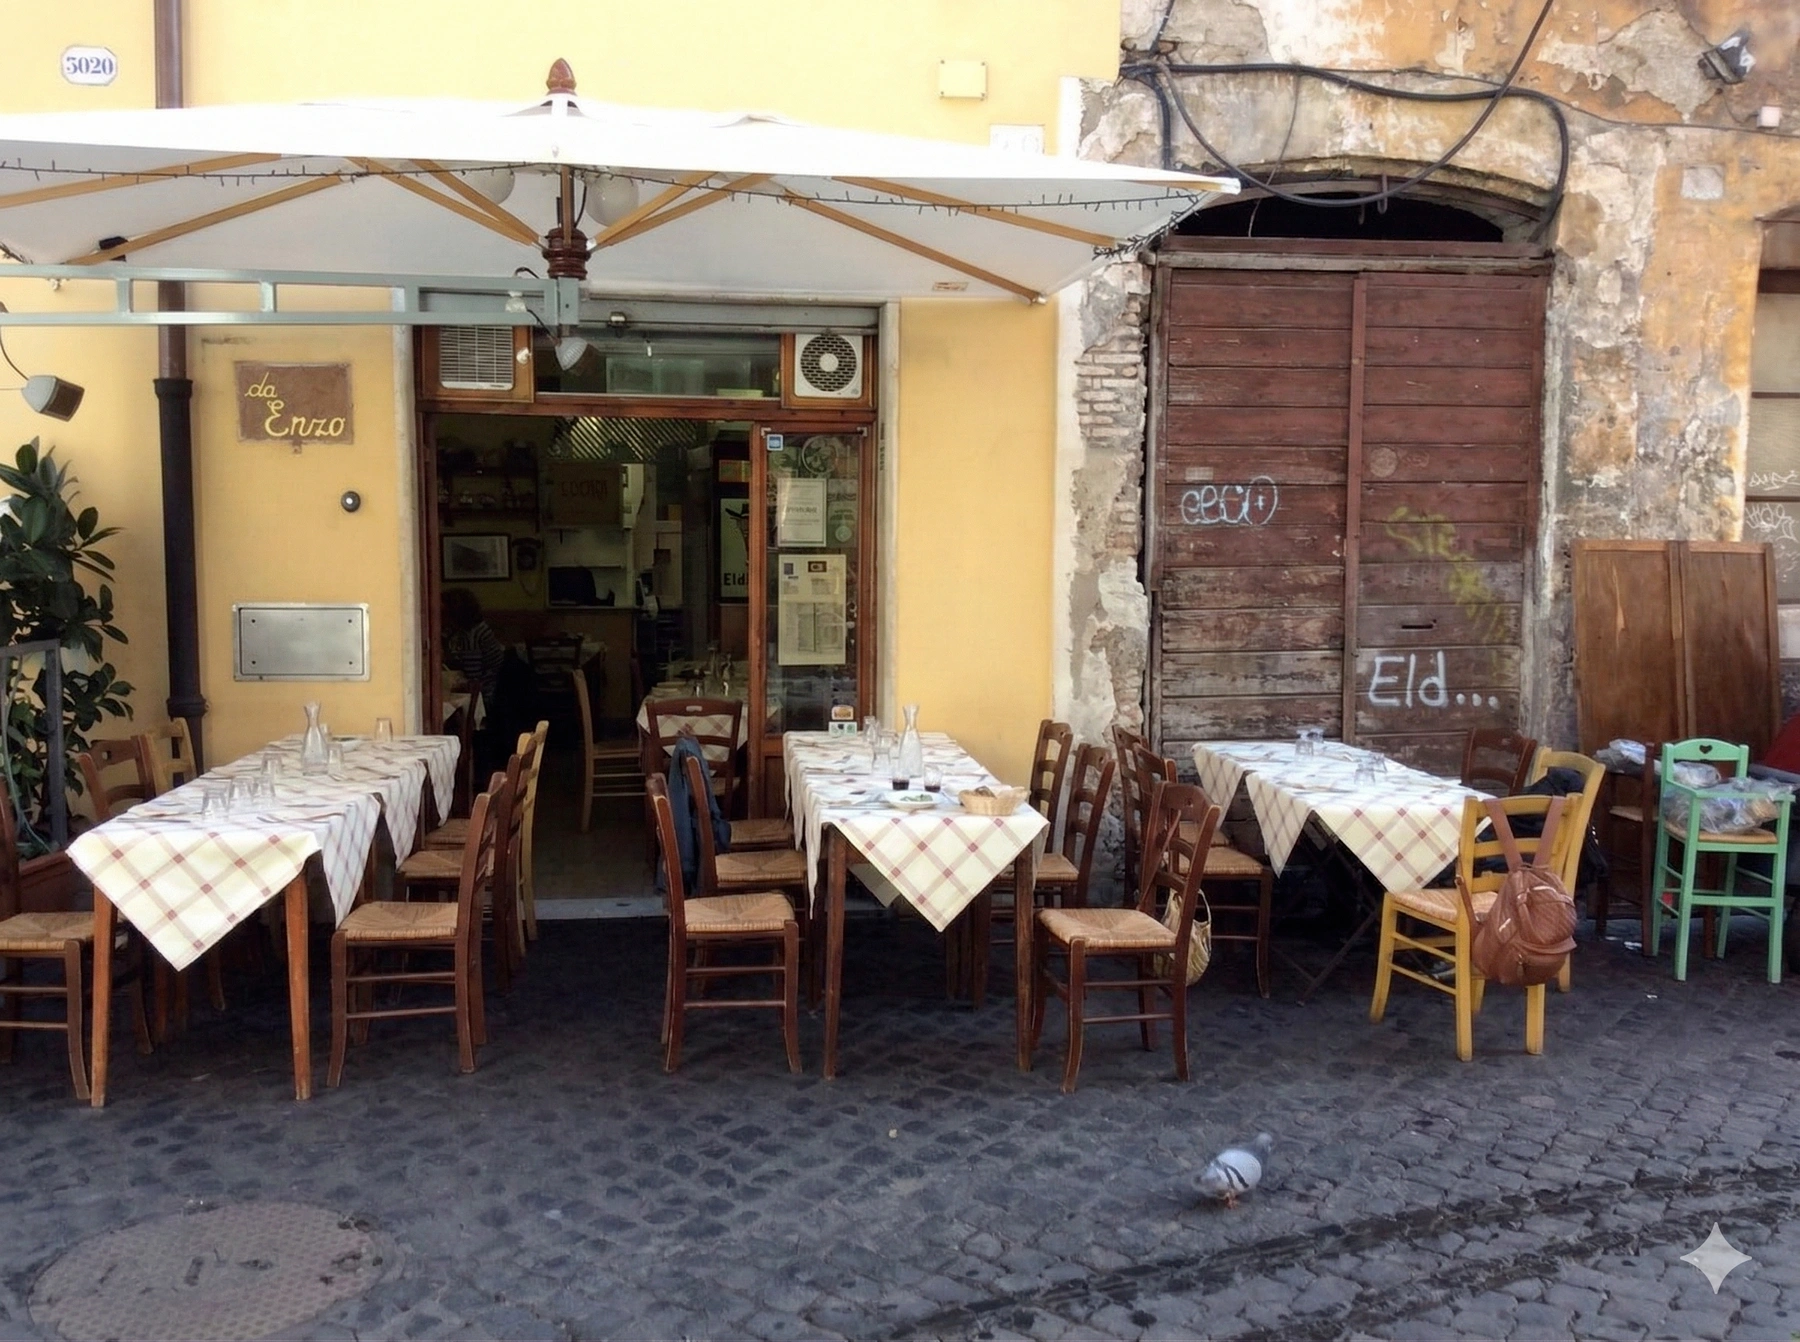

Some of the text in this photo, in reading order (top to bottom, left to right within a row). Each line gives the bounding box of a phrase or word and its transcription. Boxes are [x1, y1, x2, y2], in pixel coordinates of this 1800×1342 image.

[244, 372, 278, 398] da
[264, 399, 346, 437] Enzo
[723, 572, 749, 586] Eld
[1368, 650, 1499, 710] Eld...
